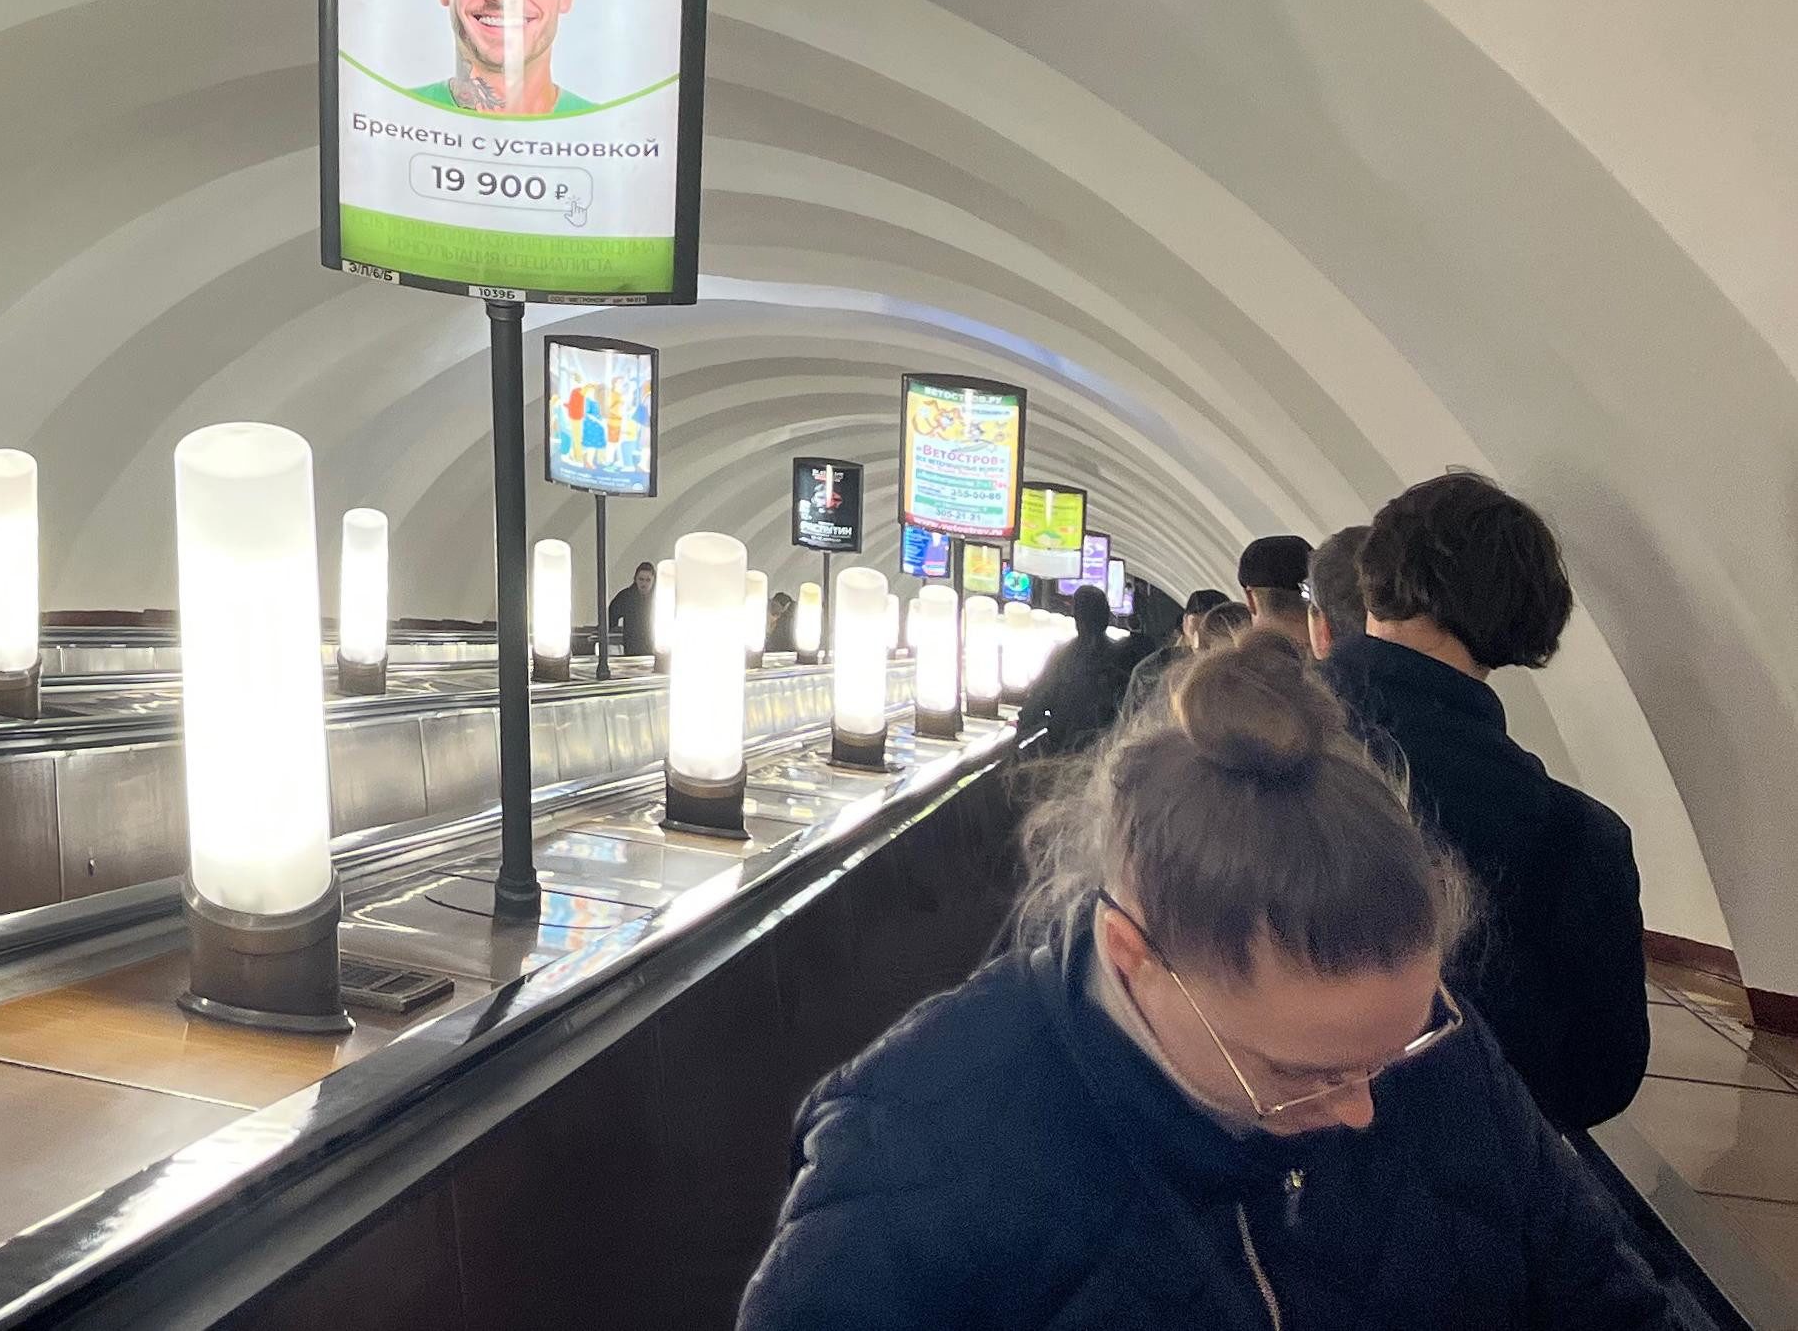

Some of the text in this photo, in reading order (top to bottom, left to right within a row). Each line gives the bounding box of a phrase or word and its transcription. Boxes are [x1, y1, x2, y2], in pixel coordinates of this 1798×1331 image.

[352, 113, 660, 158] Брекеты с установкой
[431, 165, 465, 192] 19
[477, 171, 547, 200] 900
[478, 287, 515, 300] 1039Б
[924, 386, 1002, 405] ВЕТОСТОВ.РУ
